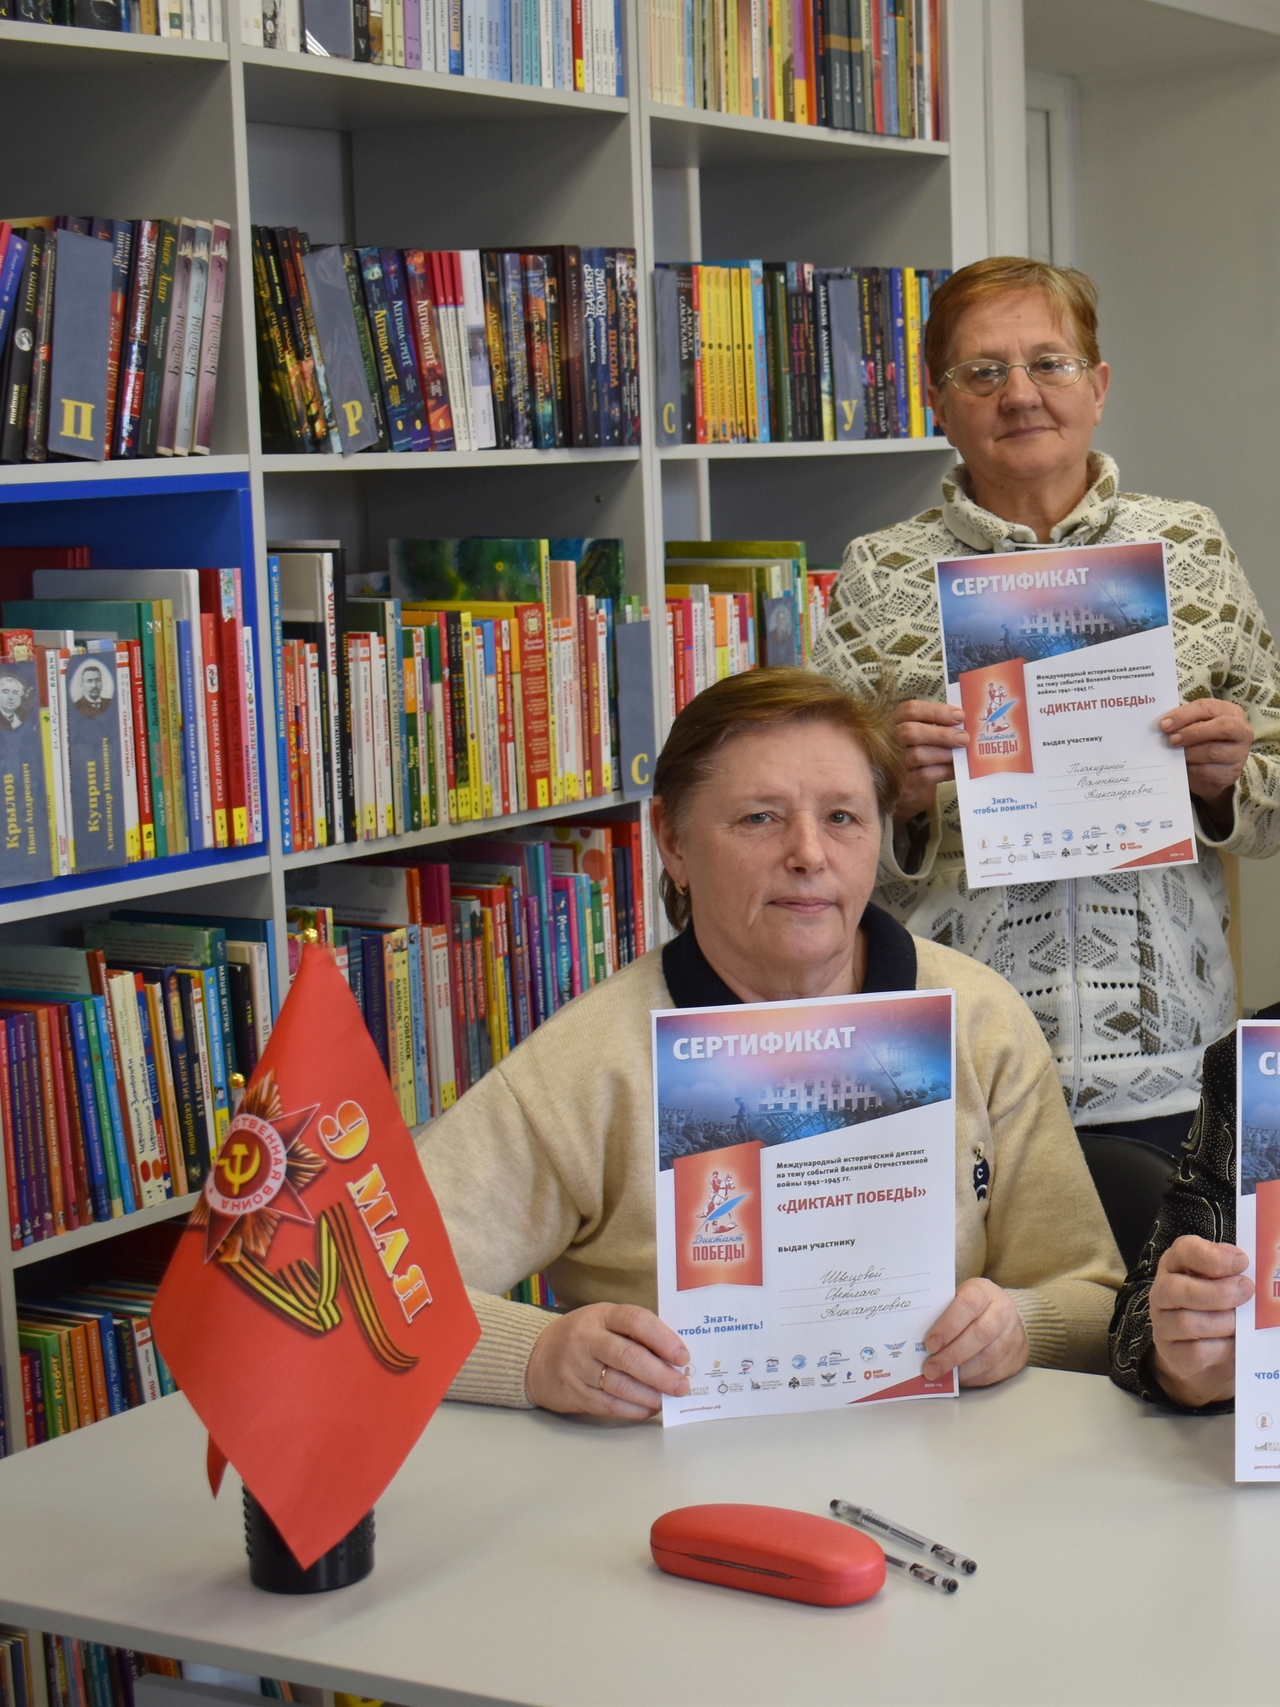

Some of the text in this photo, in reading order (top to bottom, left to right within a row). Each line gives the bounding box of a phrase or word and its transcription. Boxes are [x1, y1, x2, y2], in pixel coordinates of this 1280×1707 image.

[593, 268, 606, 319] КОМПАС
[679, 295, 689, 361] САМАРКАНДА
[609, 330, 620, 388] ШКОЛА
[60, 398, 95, 442] П
[342, 400, 363, 437] Р
[663, 402, 676, 434] С
[951, 567, 1090, 597] СЕРТИФИКАТ
[325, 592, 338, 677] ДЯДЯ СТЁПА
[1039, 694, 1156, 717] «ДИКТАНТ ПОБЕДЫ»
[212, 720, 220, 747] СОБАКА
[301, 706, 310, 754] Ограбление
[977, 731, 1017, 742] Диктант
[1042, 735, 1103, 748] выдан участнику
[978, 739, 1019, 757] ПОБЕДЫ
[631, 753, 650, 785] С
[1077, 776, 1130, 788] Валентине
[87, 760, 102, 833] Куприн
[103, 737, 115, 851] Александр Иванович
[251, 754, 260, 816] ДВЕНАДЦАТЬ
[1085, 787, 1154, 801] Александровне
[6, 773, 22, 850] Крылов
[22, 763, 37, 855] Иван Андреевич
[972, 802, 1038, 816] чтобы помнить!
[991, 795, 1018, 806] Знать,
[673, 1026, 855, 1062] СЕРТИФИКАТ
[178, 1052, 196, 1156] Заклятие скорпиона
[776, 1149, 925, 1171] Международный исторический диктант
[787, 1171, 805, 1180] тему
[807, 1166, 839, 1176] событий
[841, 1163, 872, 1172] Великой
[873, 1156, 928, 1168] Отечественной
[777, 1179, 801, 1188] войны
[318, 1100, 433, 1324] 9 МАЯ
[777, 1185, 927, 1215] «ДИКТАНТ ПОБЕДЫ»
[692, 1231, 744, 1246] Диктант
[778, 1238, 856, 1254] выдан участнику
[692, 1242, 745, 1264] ПОБЕДЫ
[820, 1266, 885, 1286] Швецовой
[825, 1287, 880, 1301] Светлане
[703, 1312, 738, 1326] Знать,
[821, 1298, 912, 1320] Александровне
[678, 1320, 763, 1338] чтобы помнить!
